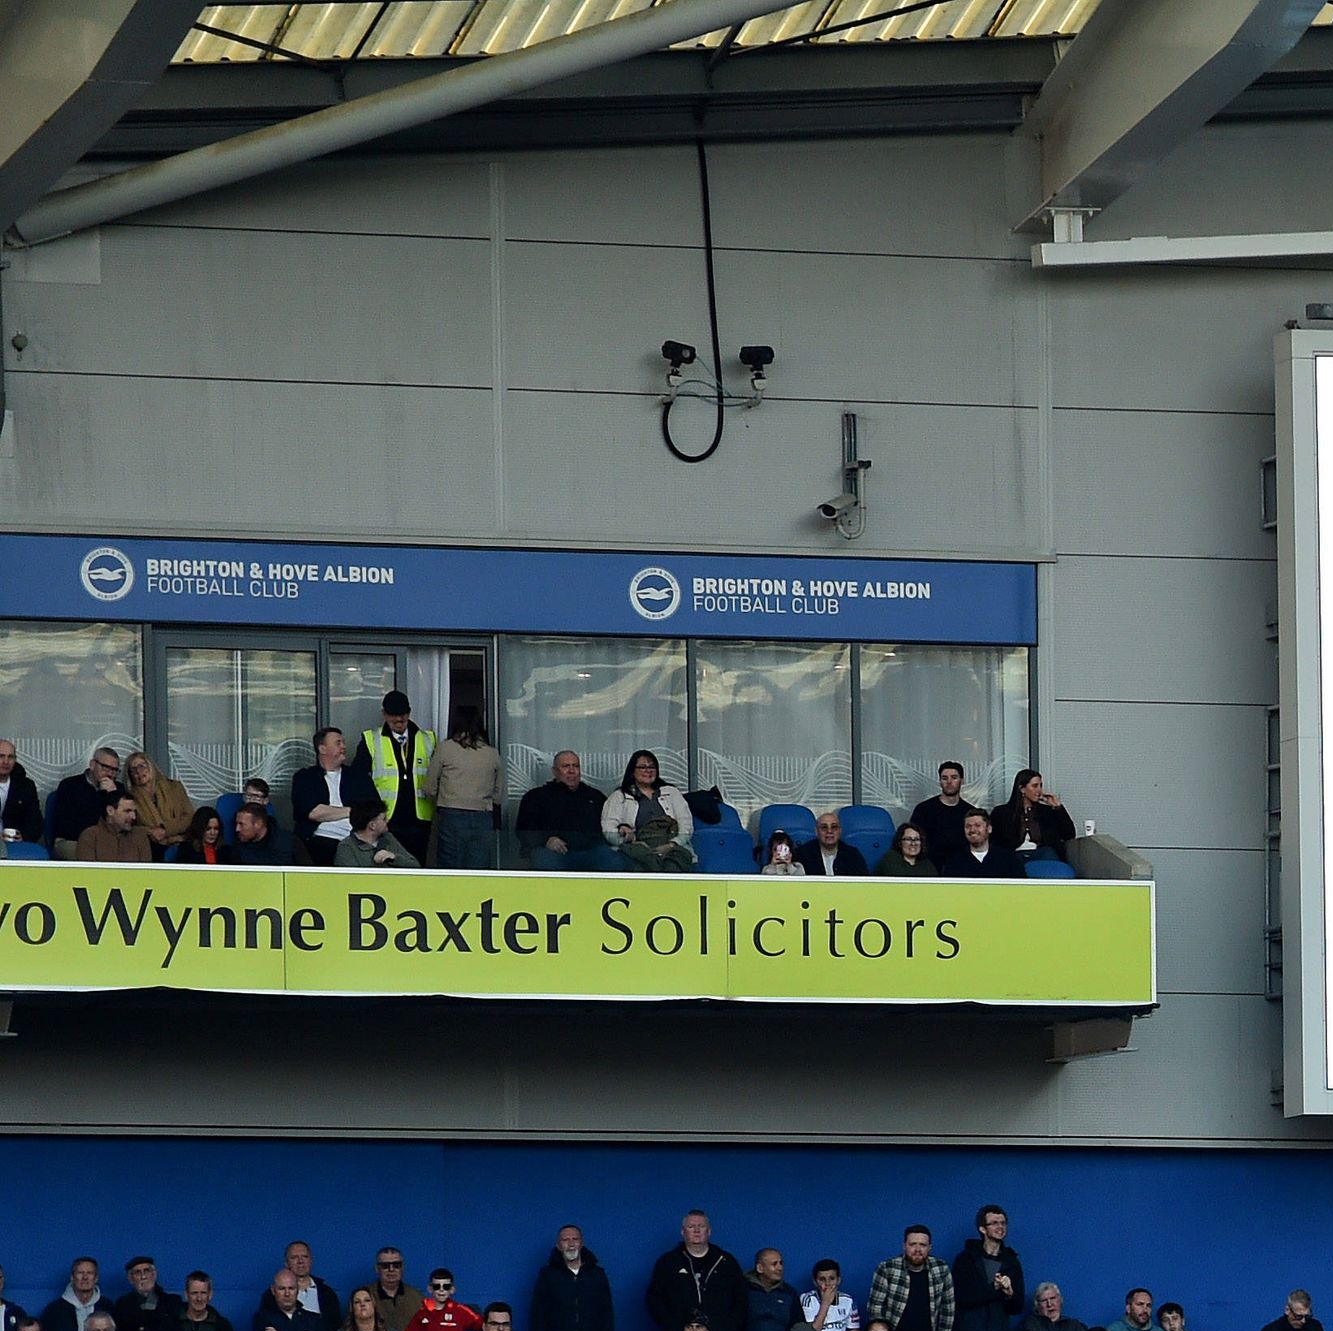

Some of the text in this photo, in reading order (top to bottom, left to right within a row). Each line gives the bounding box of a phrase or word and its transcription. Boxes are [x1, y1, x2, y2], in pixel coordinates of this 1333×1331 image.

[146, 558, 394, 584] BRIGHTON & HOVE ALBION
[147, 577, 299, 599] FOOTBALL CLUB
[692, 577, 931, 599] BRIGHTON & HOVE ALBION
[693, 595, 840, 615] FOOTBALL CLUB
[73, 886, 326, 969] Wynne
[347, 892, 572, 955] Baxter
[601, 894, 961, 961] Solicitors
